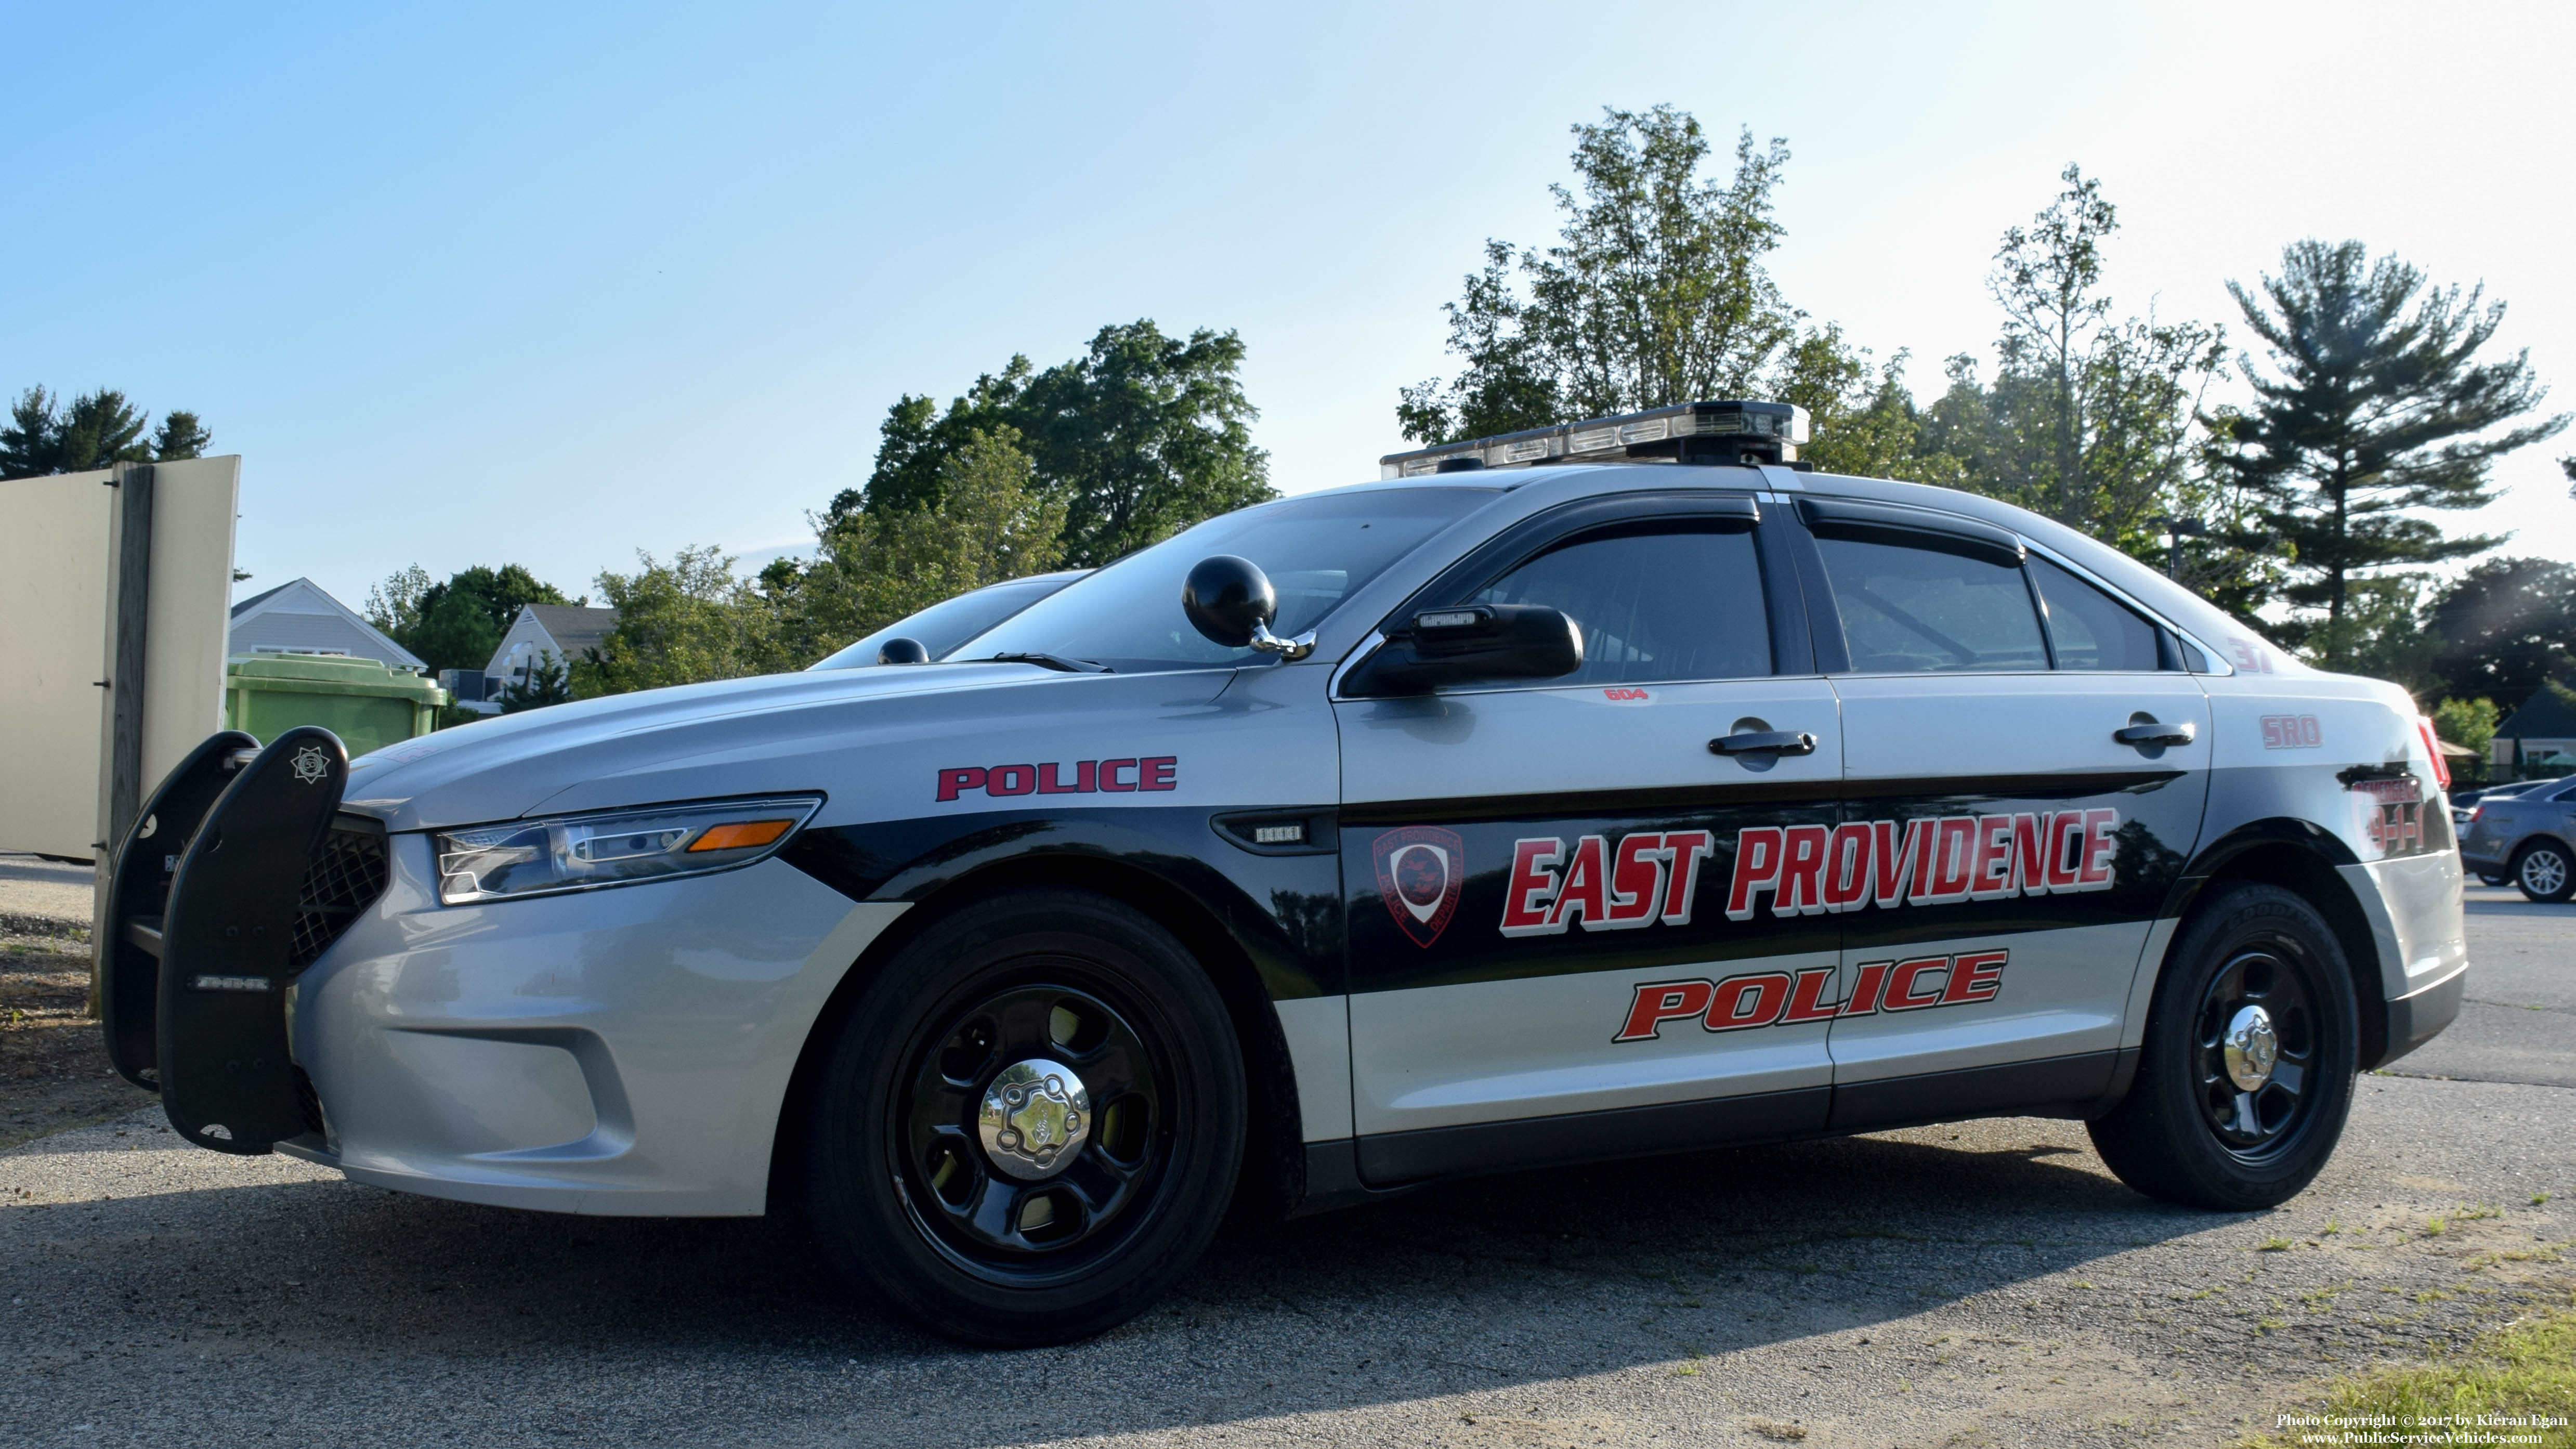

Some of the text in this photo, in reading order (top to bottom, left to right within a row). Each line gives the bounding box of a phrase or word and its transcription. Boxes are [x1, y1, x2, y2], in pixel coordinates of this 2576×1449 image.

[1603, 689, 1649, 700] 604
[2260, 714, 2322, 749] SRO
[935, 756, 1177, 802] POLICE
[1377, 829, 1461, 857] EAST PROVIDENCE
[1380, 874, 1408, 922] POLICE
[1430, 856, 1460, 932] DEPARTMENT
[1499, 830, 1715, 937] EAST
[1725, 807, 2120, 921] PROVIDENCE
[1611, 948, 2008, 1043] POLICE
